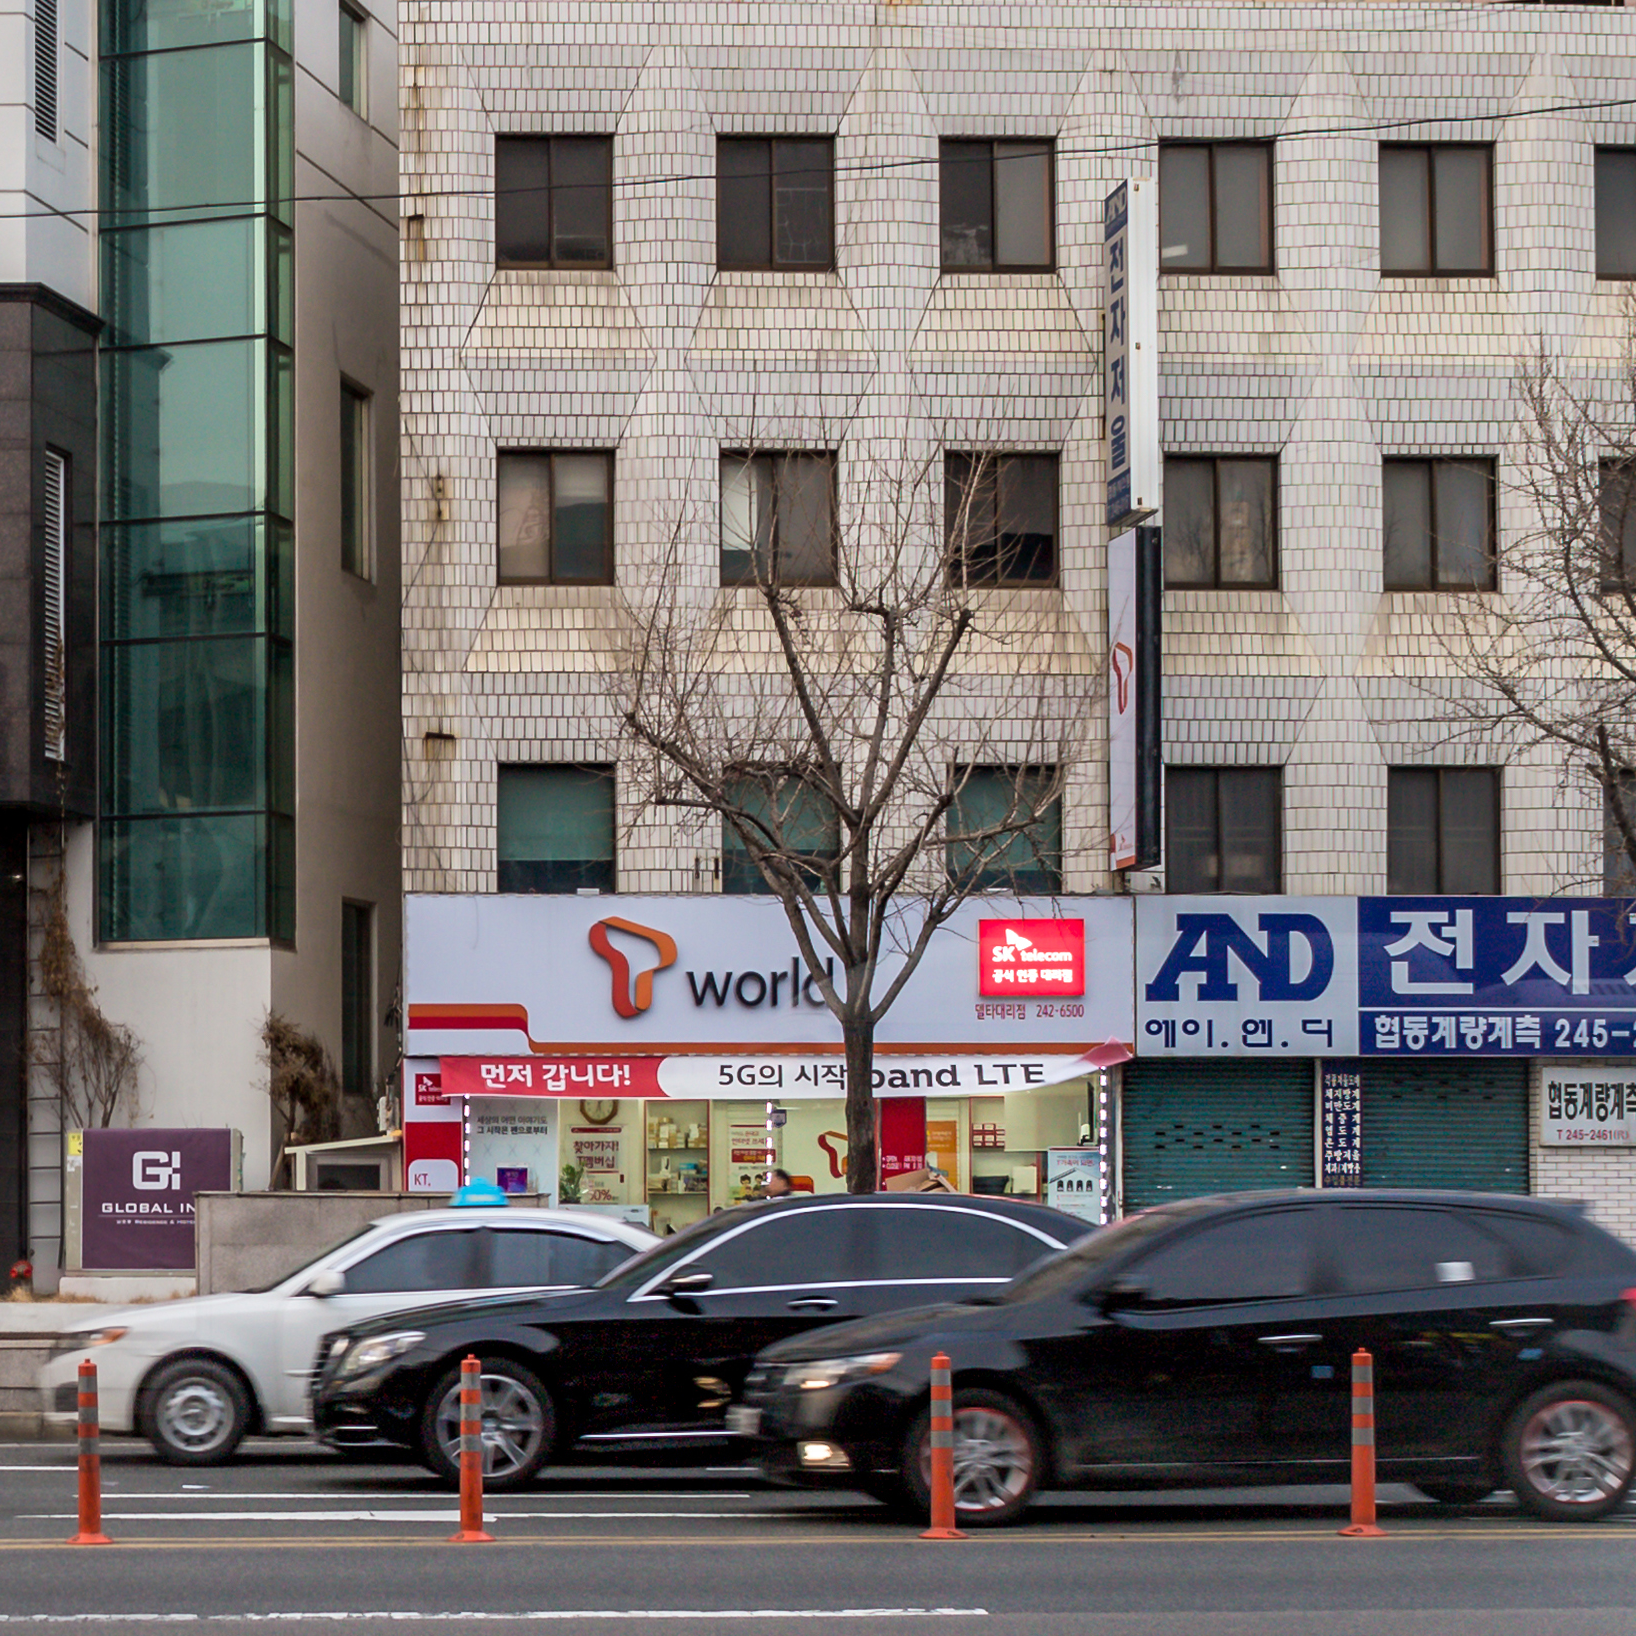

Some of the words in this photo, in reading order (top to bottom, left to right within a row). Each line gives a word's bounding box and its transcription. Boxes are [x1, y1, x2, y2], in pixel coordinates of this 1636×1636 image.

[1108, 235, 1127, 471] 전자저울
[992, 945, 1016, 962] SK
[1020, 948, 1073, 962] telecom
[1144, 912, 1335, 1002] AND
[975, 1003, 1026, 1020] 델타대리점
[1374, 1014, 1541, 1050] 협동계량계측
[1554, 1018, 1636, 1048] 245-
[480, 1064, 533, 1089] 먼저
[542, 1064, 632, 1092] 갑니다!
[718, 1064, 783, 1088] 5G의
[794, 1064, 848, 1091] 시작
[973, 1063, 1046, 1086] LTE
[101, 1203, 174, 1214] GLOBAL
